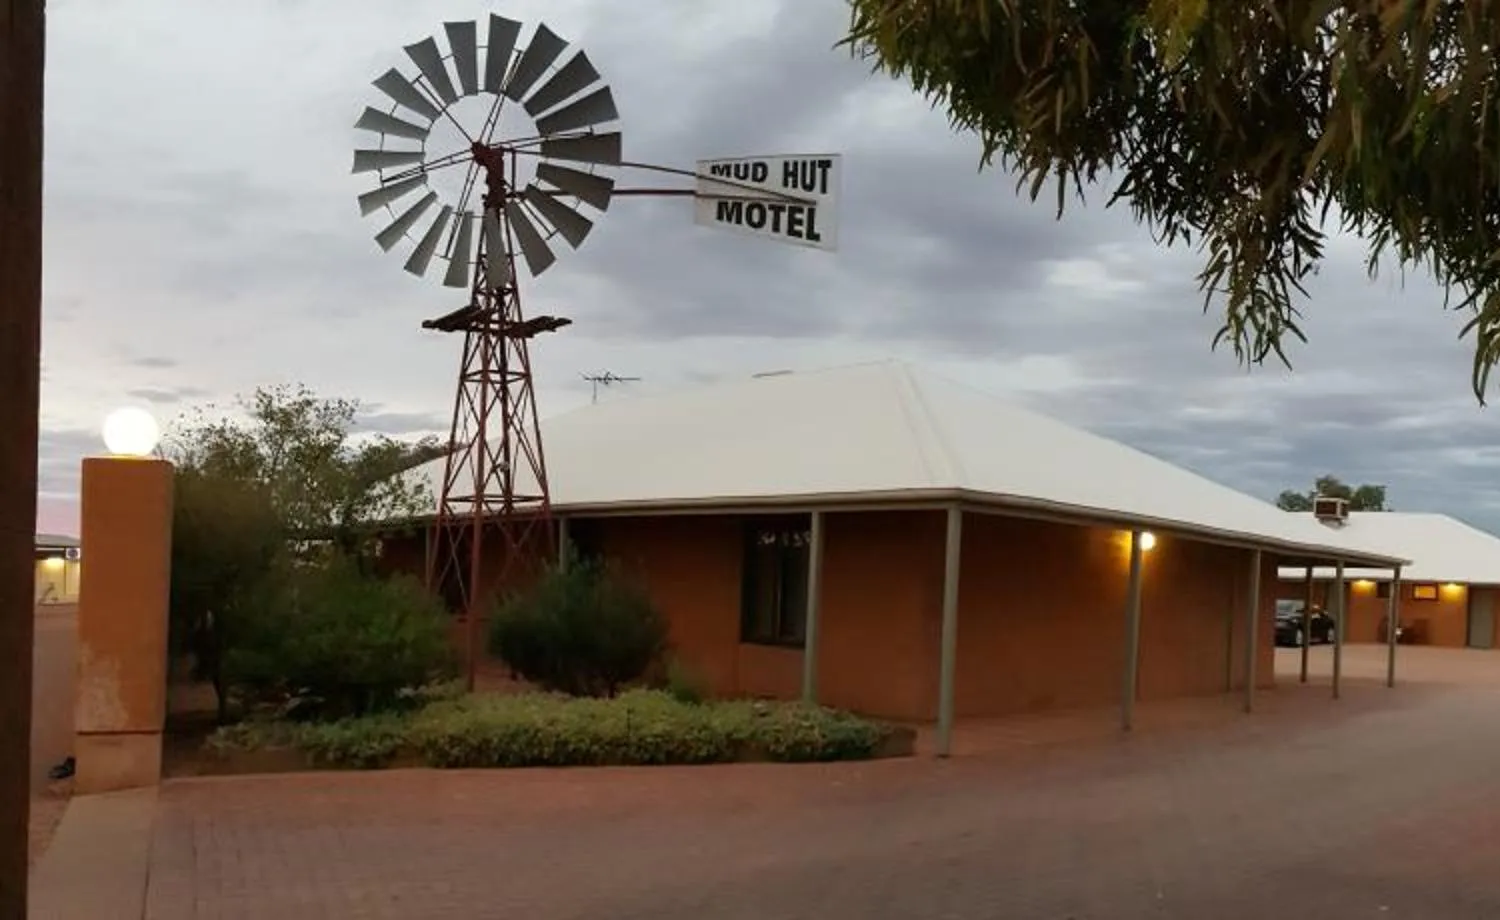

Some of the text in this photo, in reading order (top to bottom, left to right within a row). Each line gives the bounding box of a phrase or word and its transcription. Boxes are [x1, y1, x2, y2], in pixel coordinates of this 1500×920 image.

[710, 159, 832, 194] MUD HUT
[716, 201, 821, 242] MOTEL
